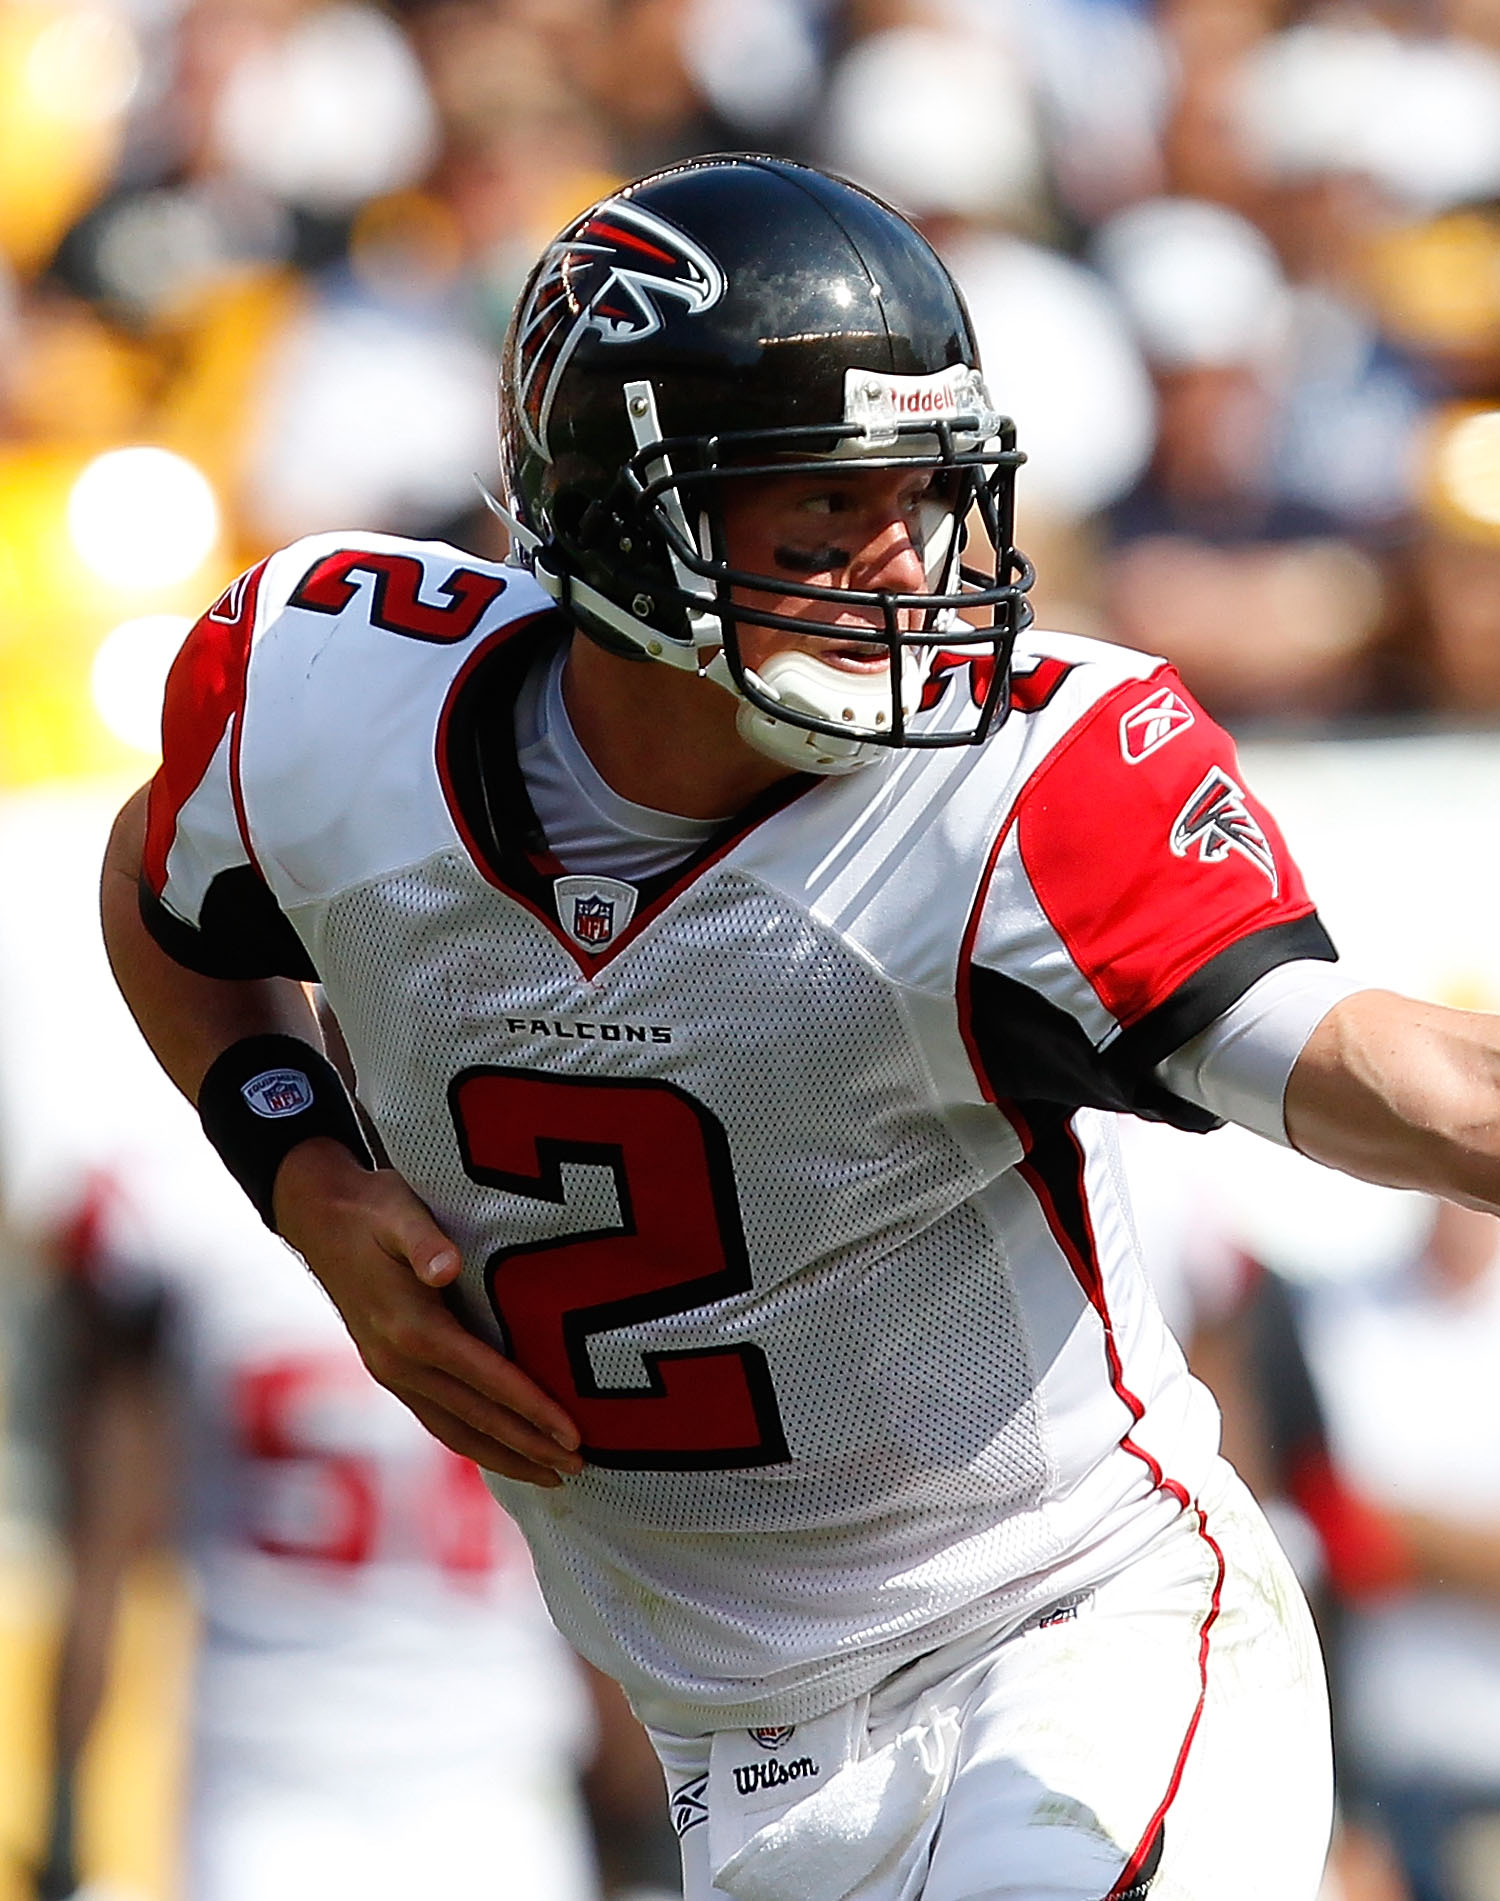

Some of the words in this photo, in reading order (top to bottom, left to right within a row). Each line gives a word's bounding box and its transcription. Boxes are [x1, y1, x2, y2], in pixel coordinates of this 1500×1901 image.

[287, 549, 507, 645] 2
[505, 1017, 673, 1044] FALCONS
[447, 1065, 792, 1472] 2
[732, 1757, 820, 1795] Wilson
